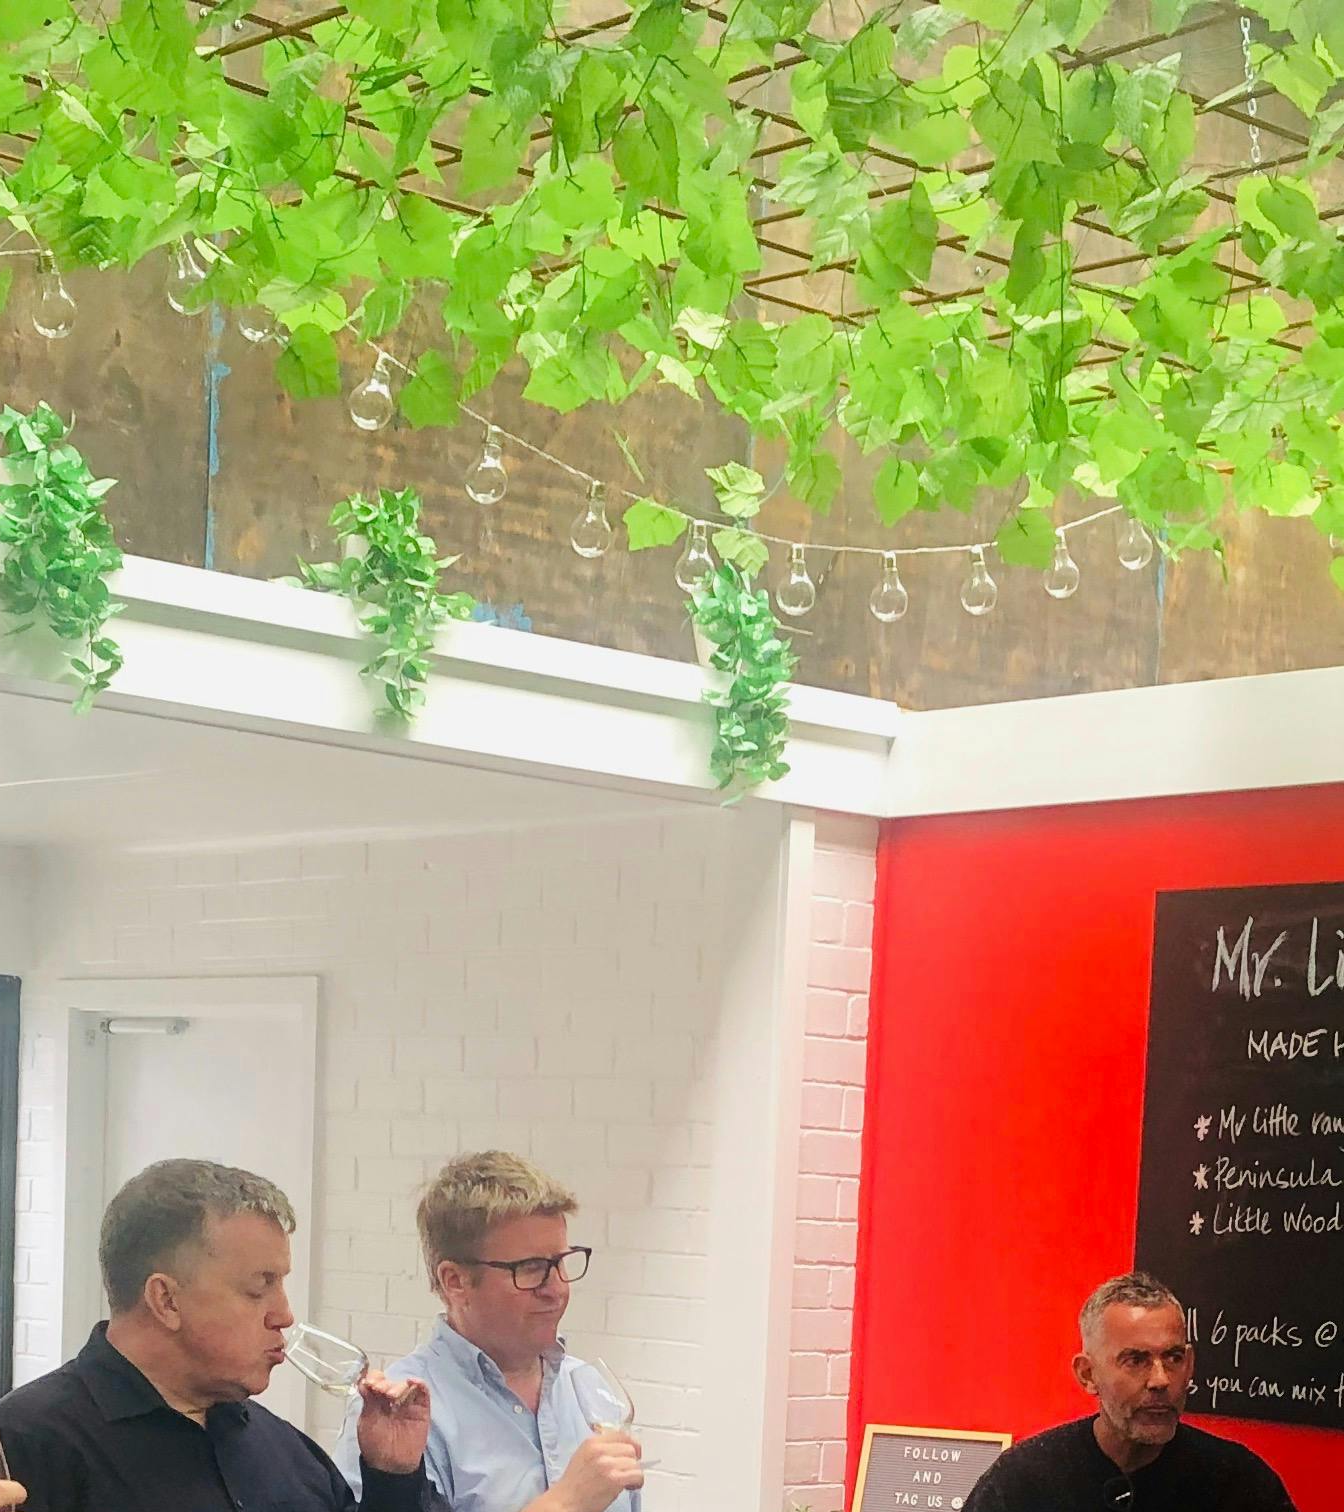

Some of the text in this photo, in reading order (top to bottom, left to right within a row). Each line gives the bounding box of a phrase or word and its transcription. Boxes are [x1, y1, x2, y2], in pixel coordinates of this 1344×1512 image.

[1213, 915, 1289, 1000] Mr.
[1248, 1028, 1327, 1062] MADE
[1219, 1105, 1247, 1144] Mr
[1252, 1104, 1301, 1137] Little
[1214, 1156, 1342, 1192] Peninsula
[1212, 1204, 1272, 1236] Little
[1211, 1309, 1227, 1345] 6
[1234, 1315, 1303, 1367] packs
[1315, 1321, 1338, 1347] @
[1206, 1376, 1243, 1409] you
[1248, 1376, 1285, 1398] can
[1292, 1384, 1326, 1403] mix
[903, 1446, 962, 1463] FOLLOW
[912, 1470, 942, 1485] AND
[894, 1492, 944, 1508] TAG US
